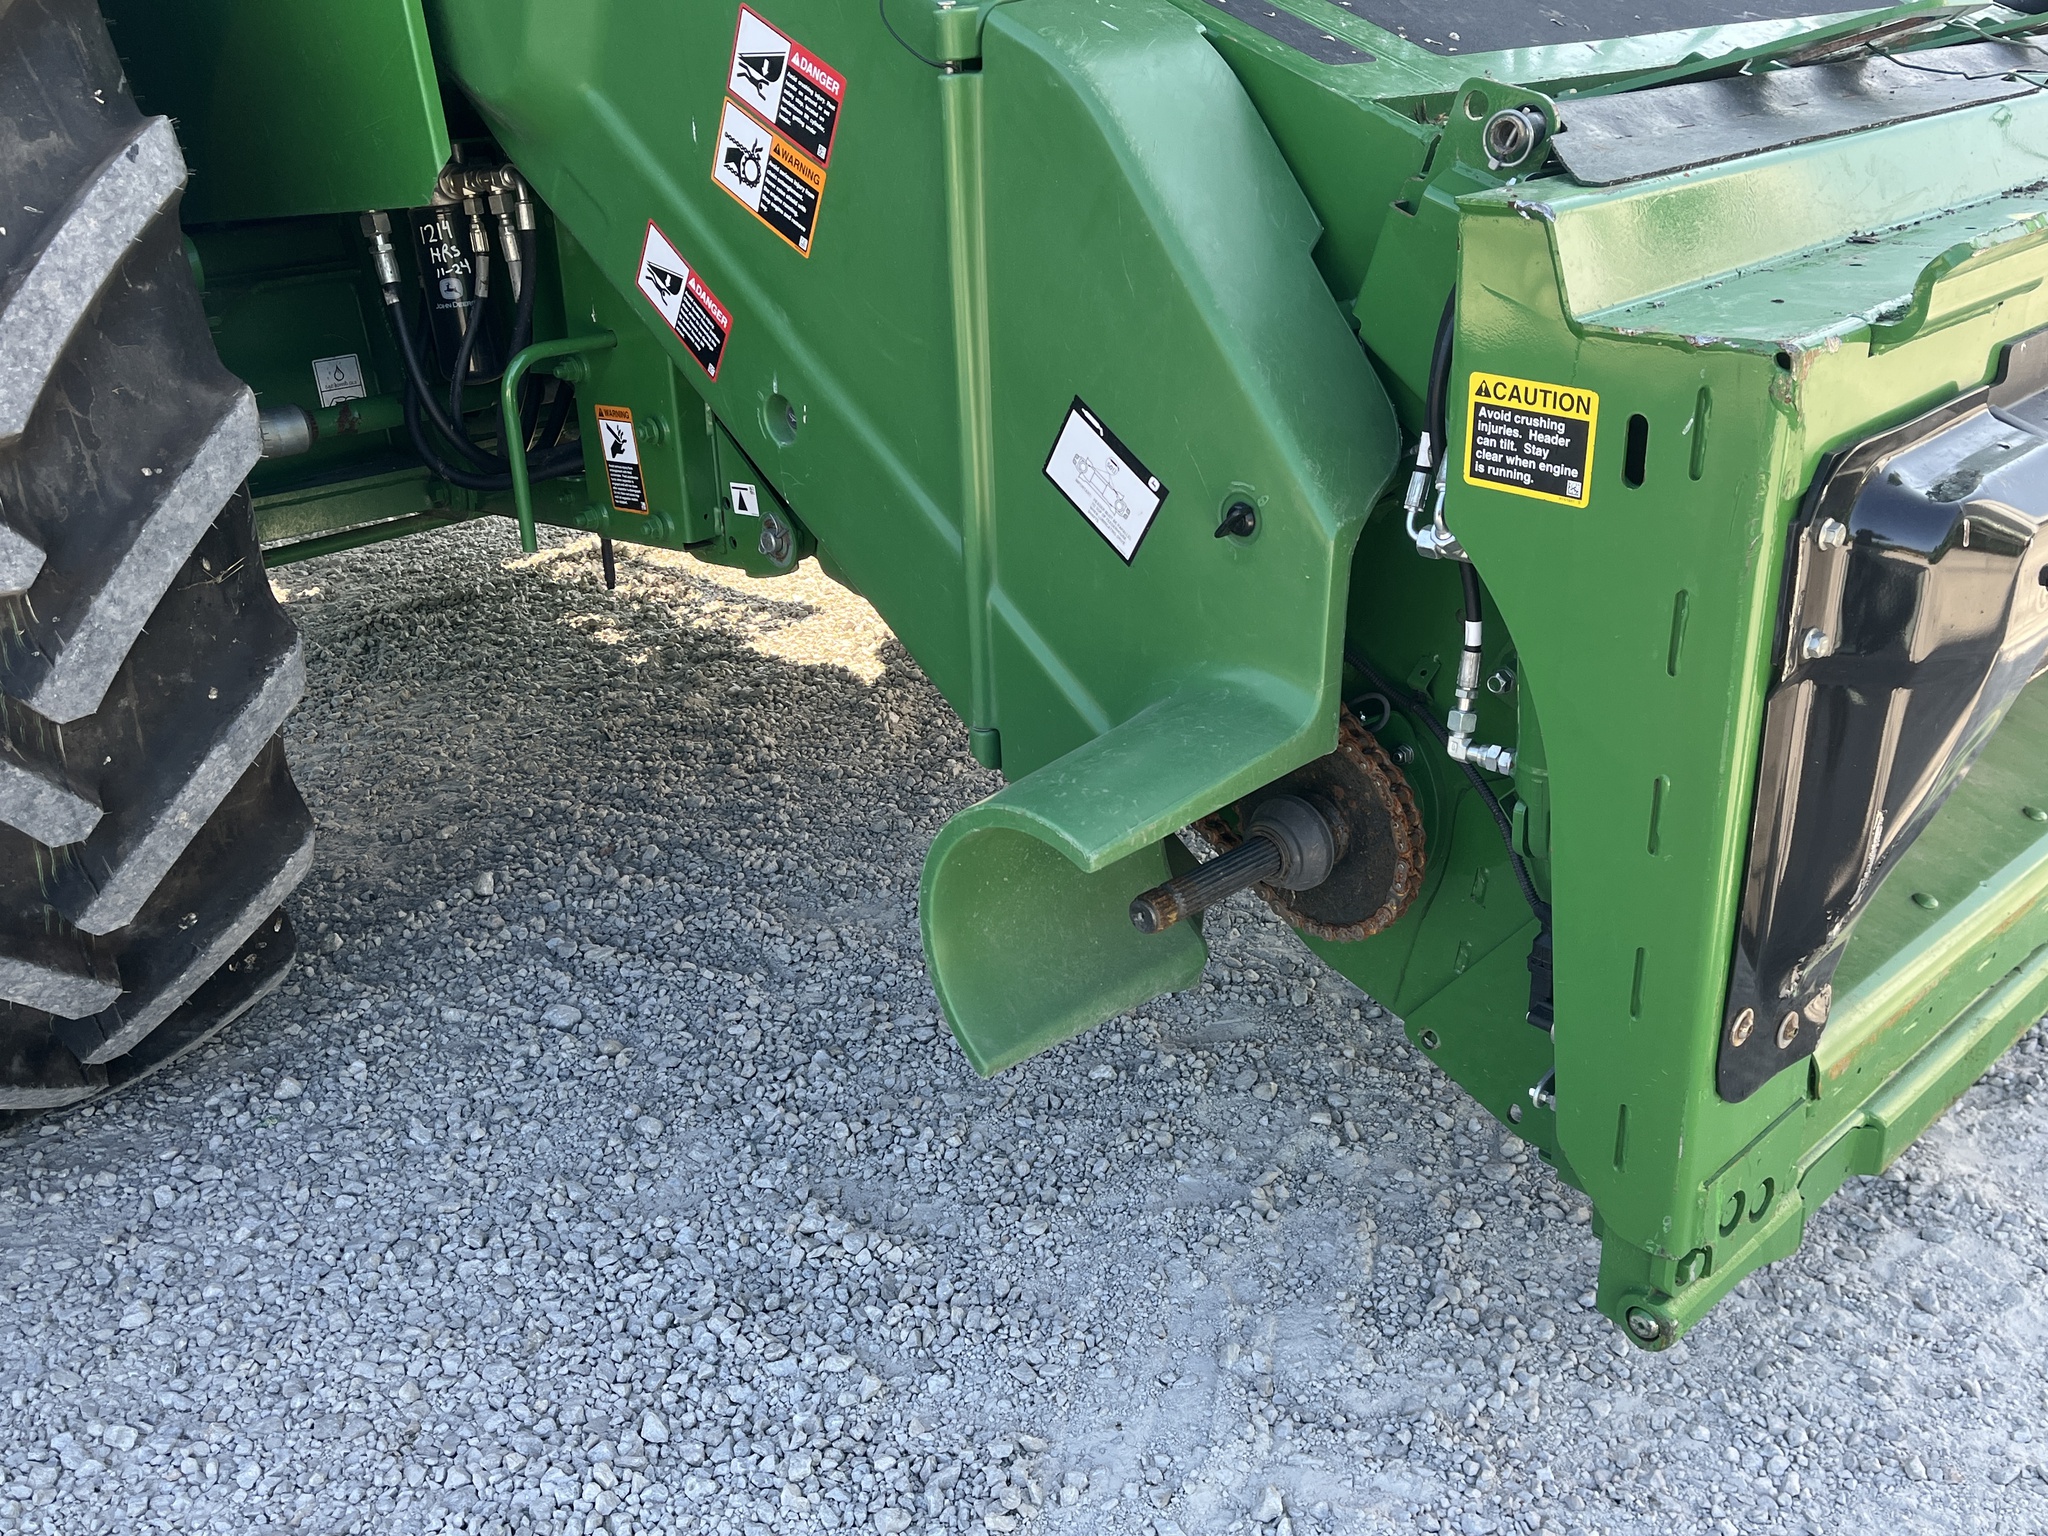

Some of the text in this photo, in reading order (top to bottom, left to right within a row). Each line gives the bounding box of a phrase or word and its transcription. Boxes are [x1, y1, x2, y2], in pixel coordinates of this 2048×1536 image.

[800, 57, 839, 96] DANGER
[781, 148, 820, 186] WARNING
[420, 220, 453, 244] 1214
[436, 258, 471, 278] 11-24
[436, 301, 452, 310] JOHN
[696, 285, 728, 328] DANGER
[1493, 382, 1591, 415] CAUTION
[1477, 420, 1571, 447] injuries. Header
[1478, 406, 1566, 434] Avoid crushing
[1476, 436, 1550, 460] can tilt. Stay
[1474, 461, 1534, 485] is running.
[1475, 449, 1579, 478] clear when engine
